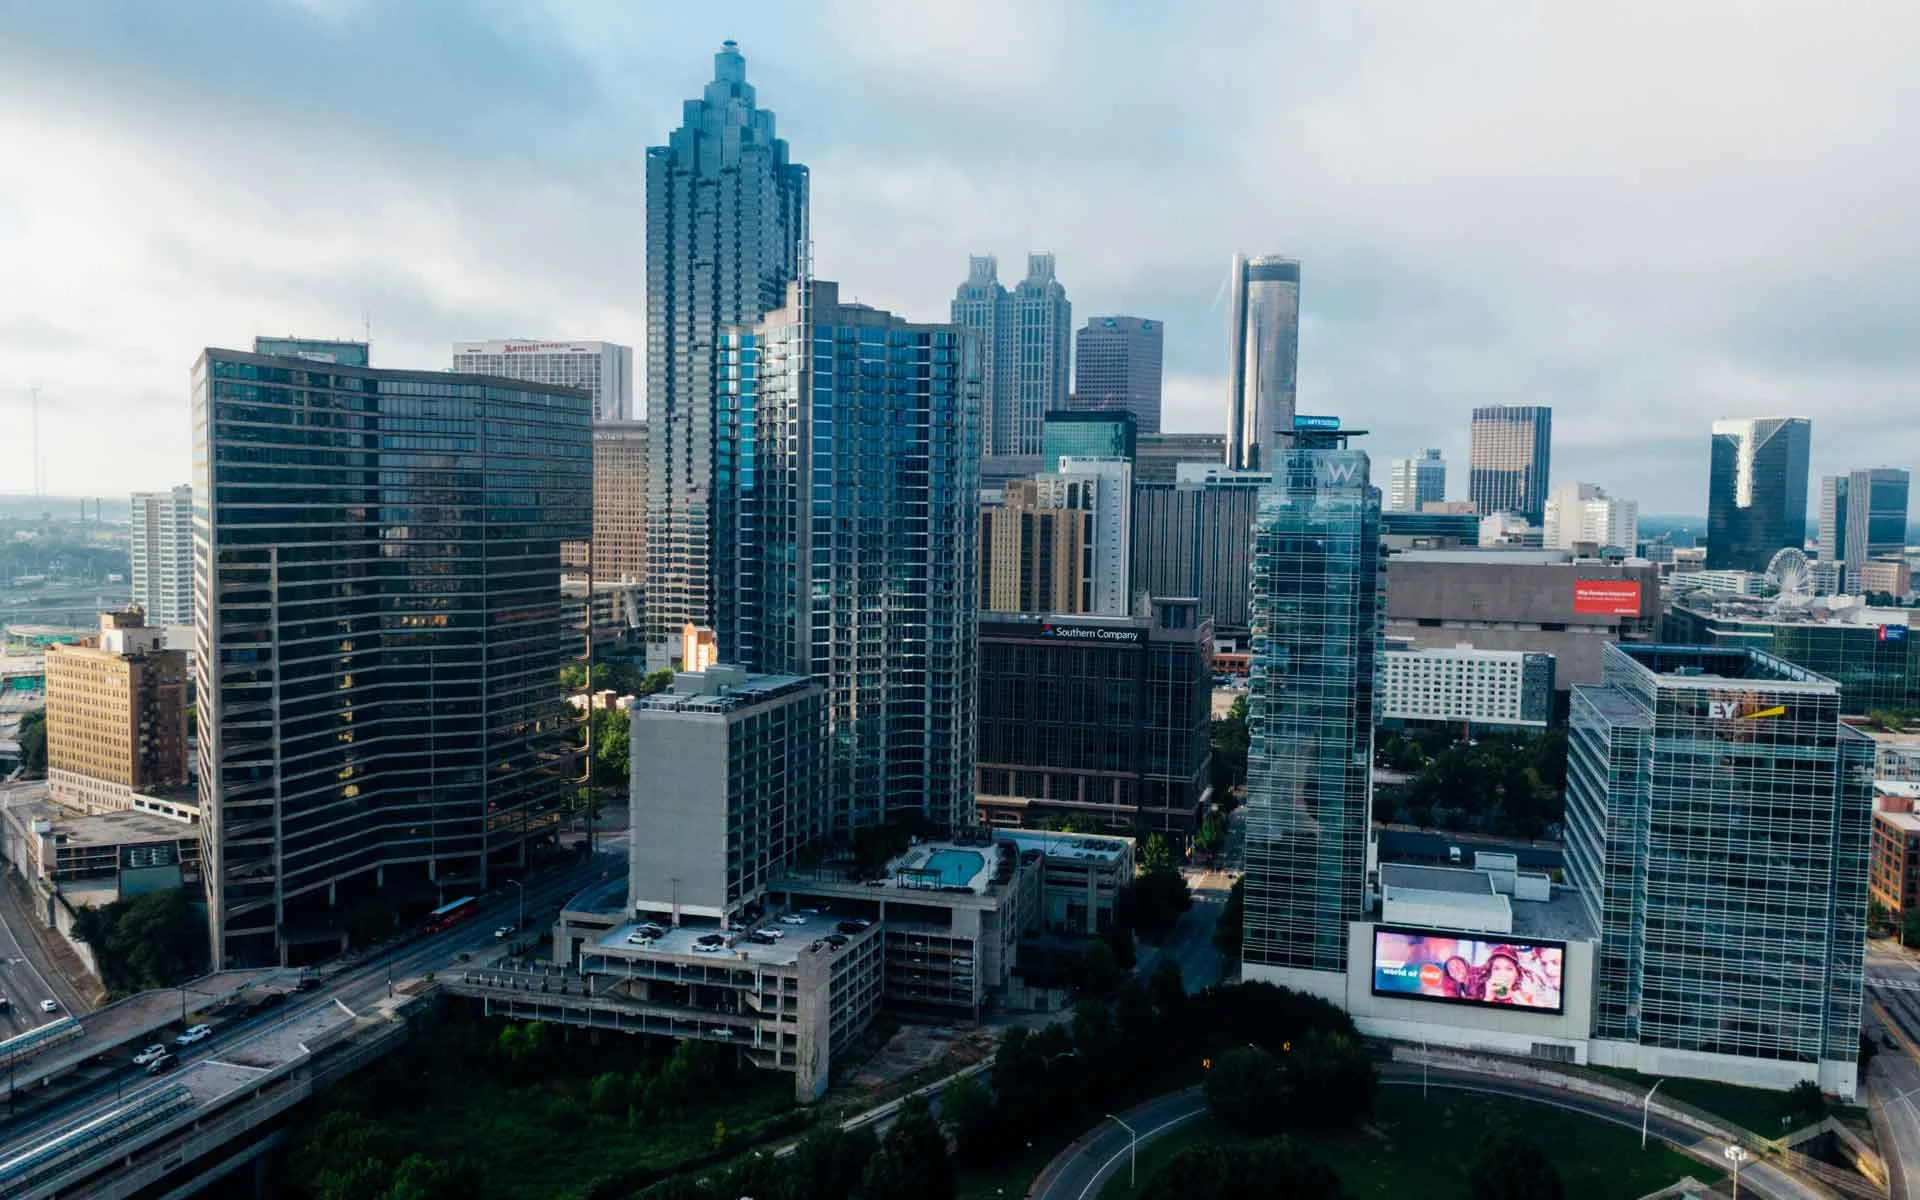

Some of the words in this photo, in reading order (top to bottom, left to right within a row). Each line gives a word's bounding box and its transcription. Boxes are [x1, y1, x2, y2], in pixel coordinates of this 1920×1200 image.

[504, 344, 539, 353] Marriott
[1328, 463, 1357, 482] W
[1056, 627, 1096, 638] Southern
[1097, 629, 1138, 641] Company
[1709, 702, 1737, 719] EY
